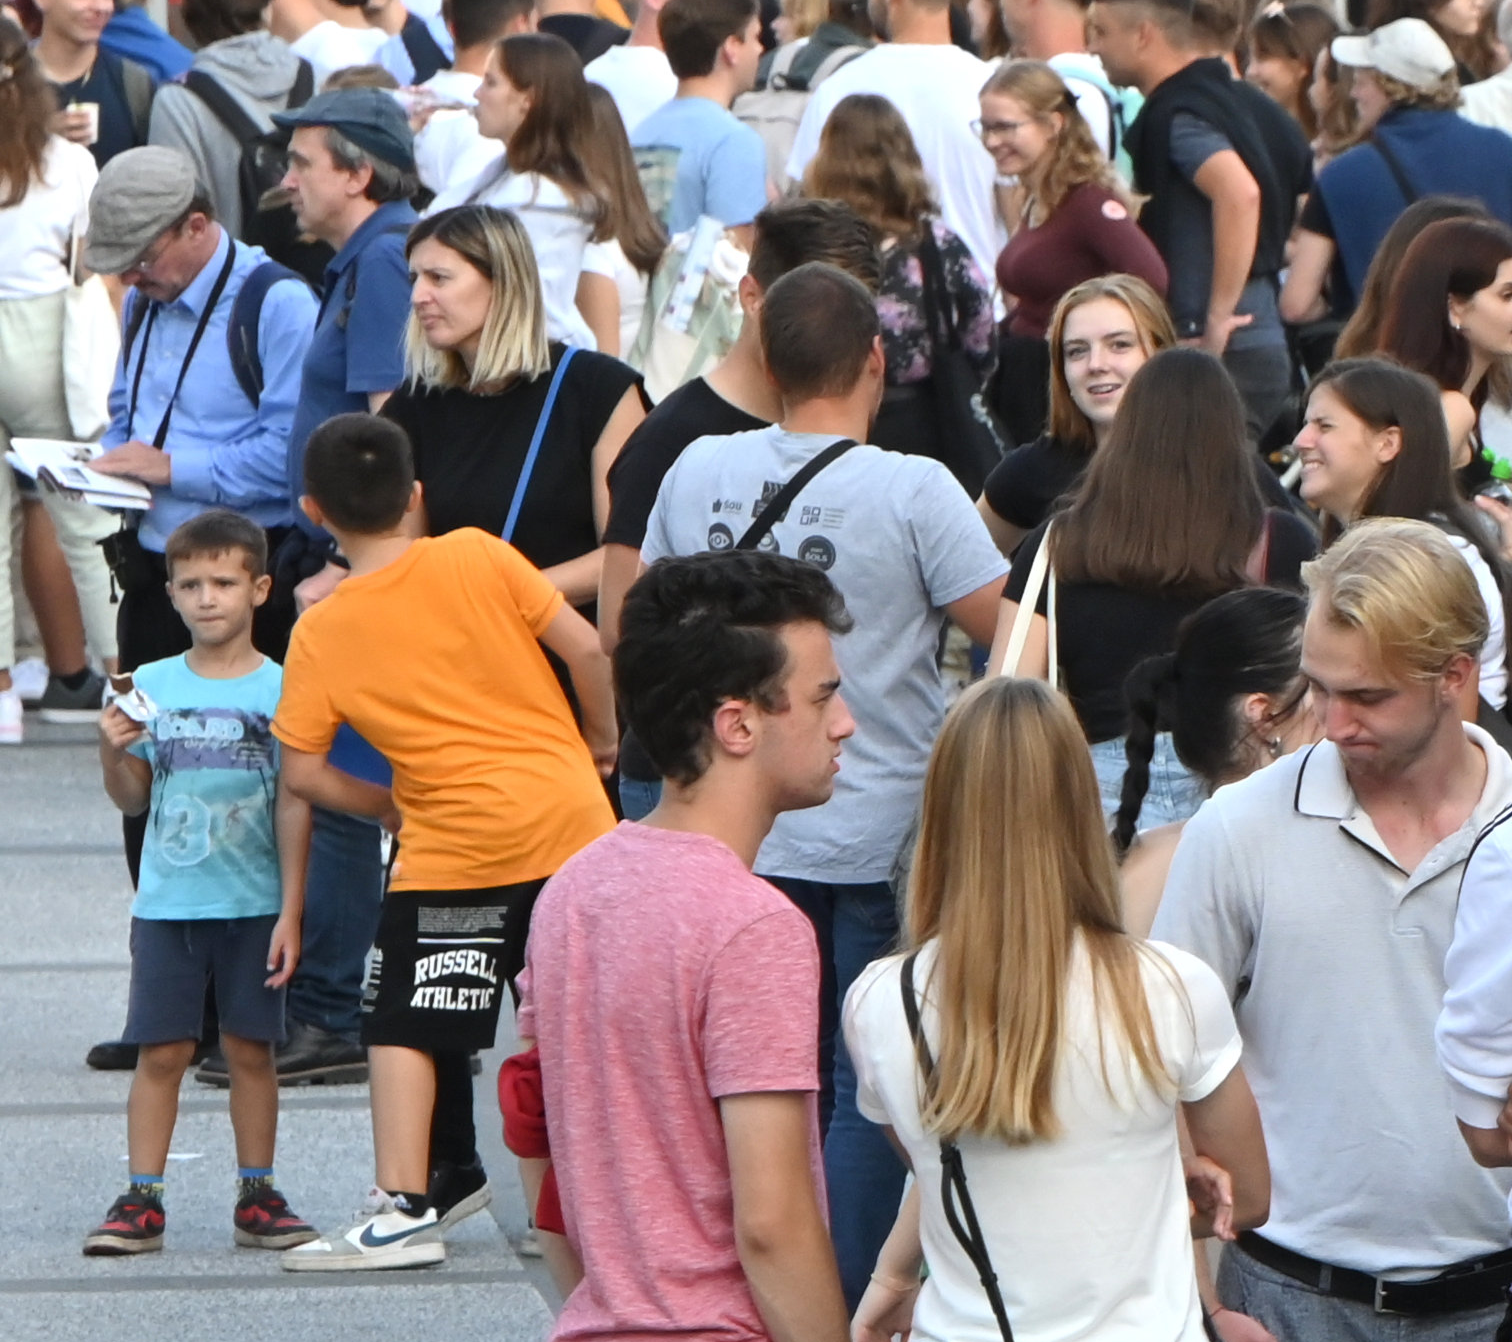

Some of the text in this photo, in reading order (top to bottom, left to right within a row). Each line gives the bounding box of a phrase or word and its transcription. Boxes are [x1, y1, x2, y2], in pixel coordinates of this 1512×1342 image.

[161, 794, 211, 867] 3
[414, 949, 497, 986] RUSSELL
[410, 986, 495, 1011] ATHLETIC
